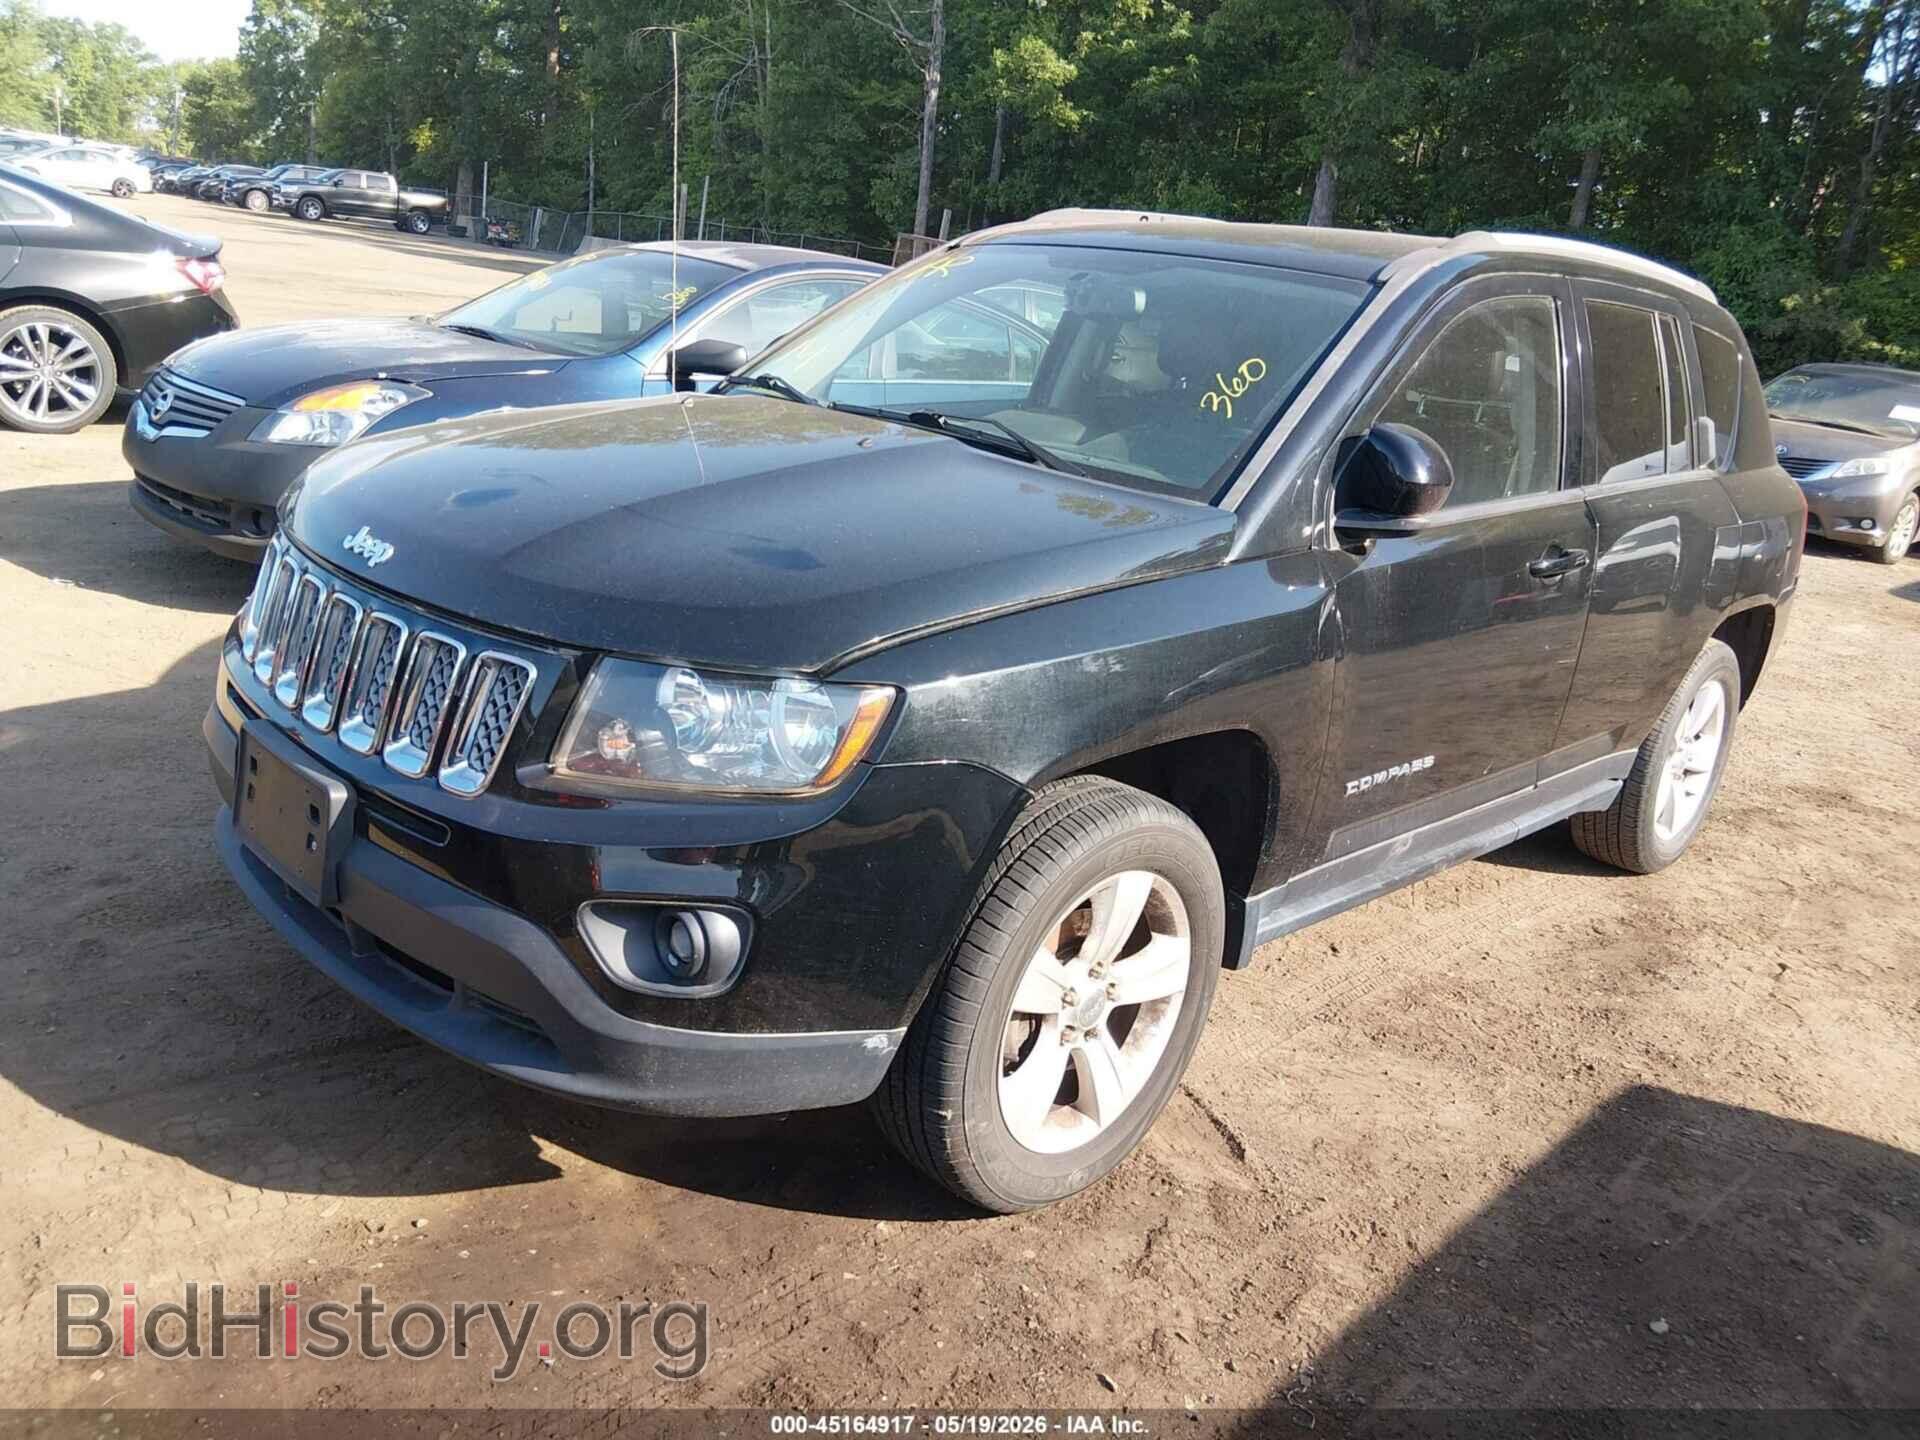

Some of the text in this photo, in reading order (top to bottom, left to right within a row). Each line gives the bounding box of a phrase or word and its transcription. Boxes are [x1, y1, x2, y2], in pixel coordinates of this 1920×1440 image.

[1200, 358, 1267, 419] 360
[343, 526, 395, 567] Jeep
[1344, 755, 1436, 798] COMPASS
